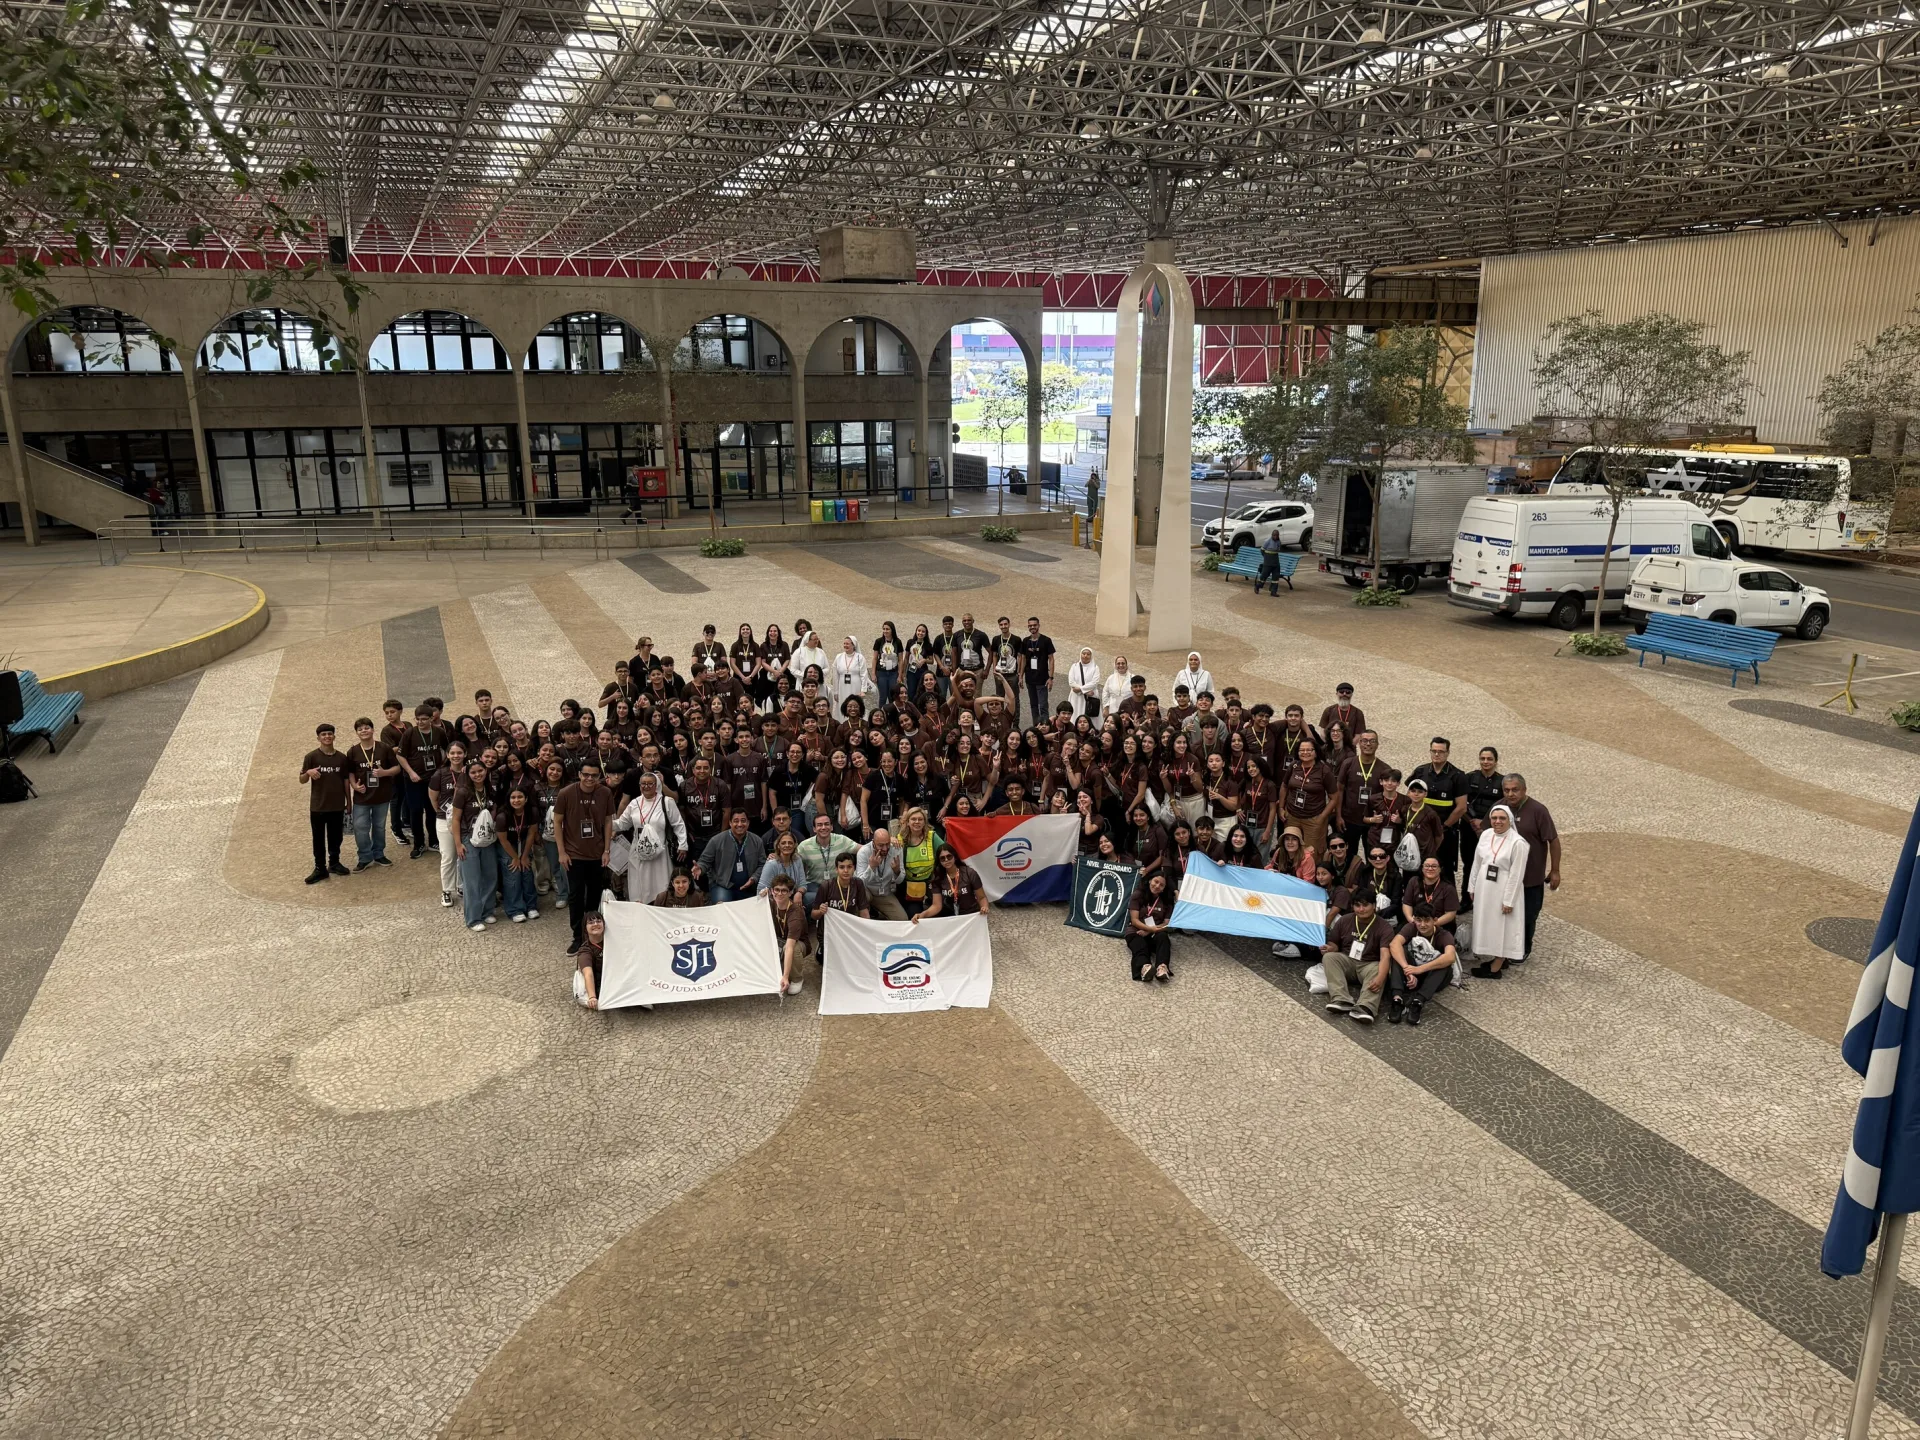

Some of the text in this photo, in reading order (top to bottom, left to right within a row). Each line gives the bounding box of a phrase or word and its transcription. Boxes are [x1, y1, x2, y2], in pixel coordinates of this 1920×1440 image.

[981, 336, 987, 345] F
[1532, 513, 1548, 521] 263
[1497, 548, 1510, 556] 263
[1529, 547, 1568, 555] MANUTENÇÃO
[1651, 546, 1671, 554] METRÔ
[1086, 860, 1100, 868] NIVEL
[1103, 863, 1132, 873] SECUNDARIO
[666, 926, 719, 940] COLÉGIO
[676, 943, 712, 977] SJT
[650, 972, 737, 993] SÃO JUDAS TADEU
